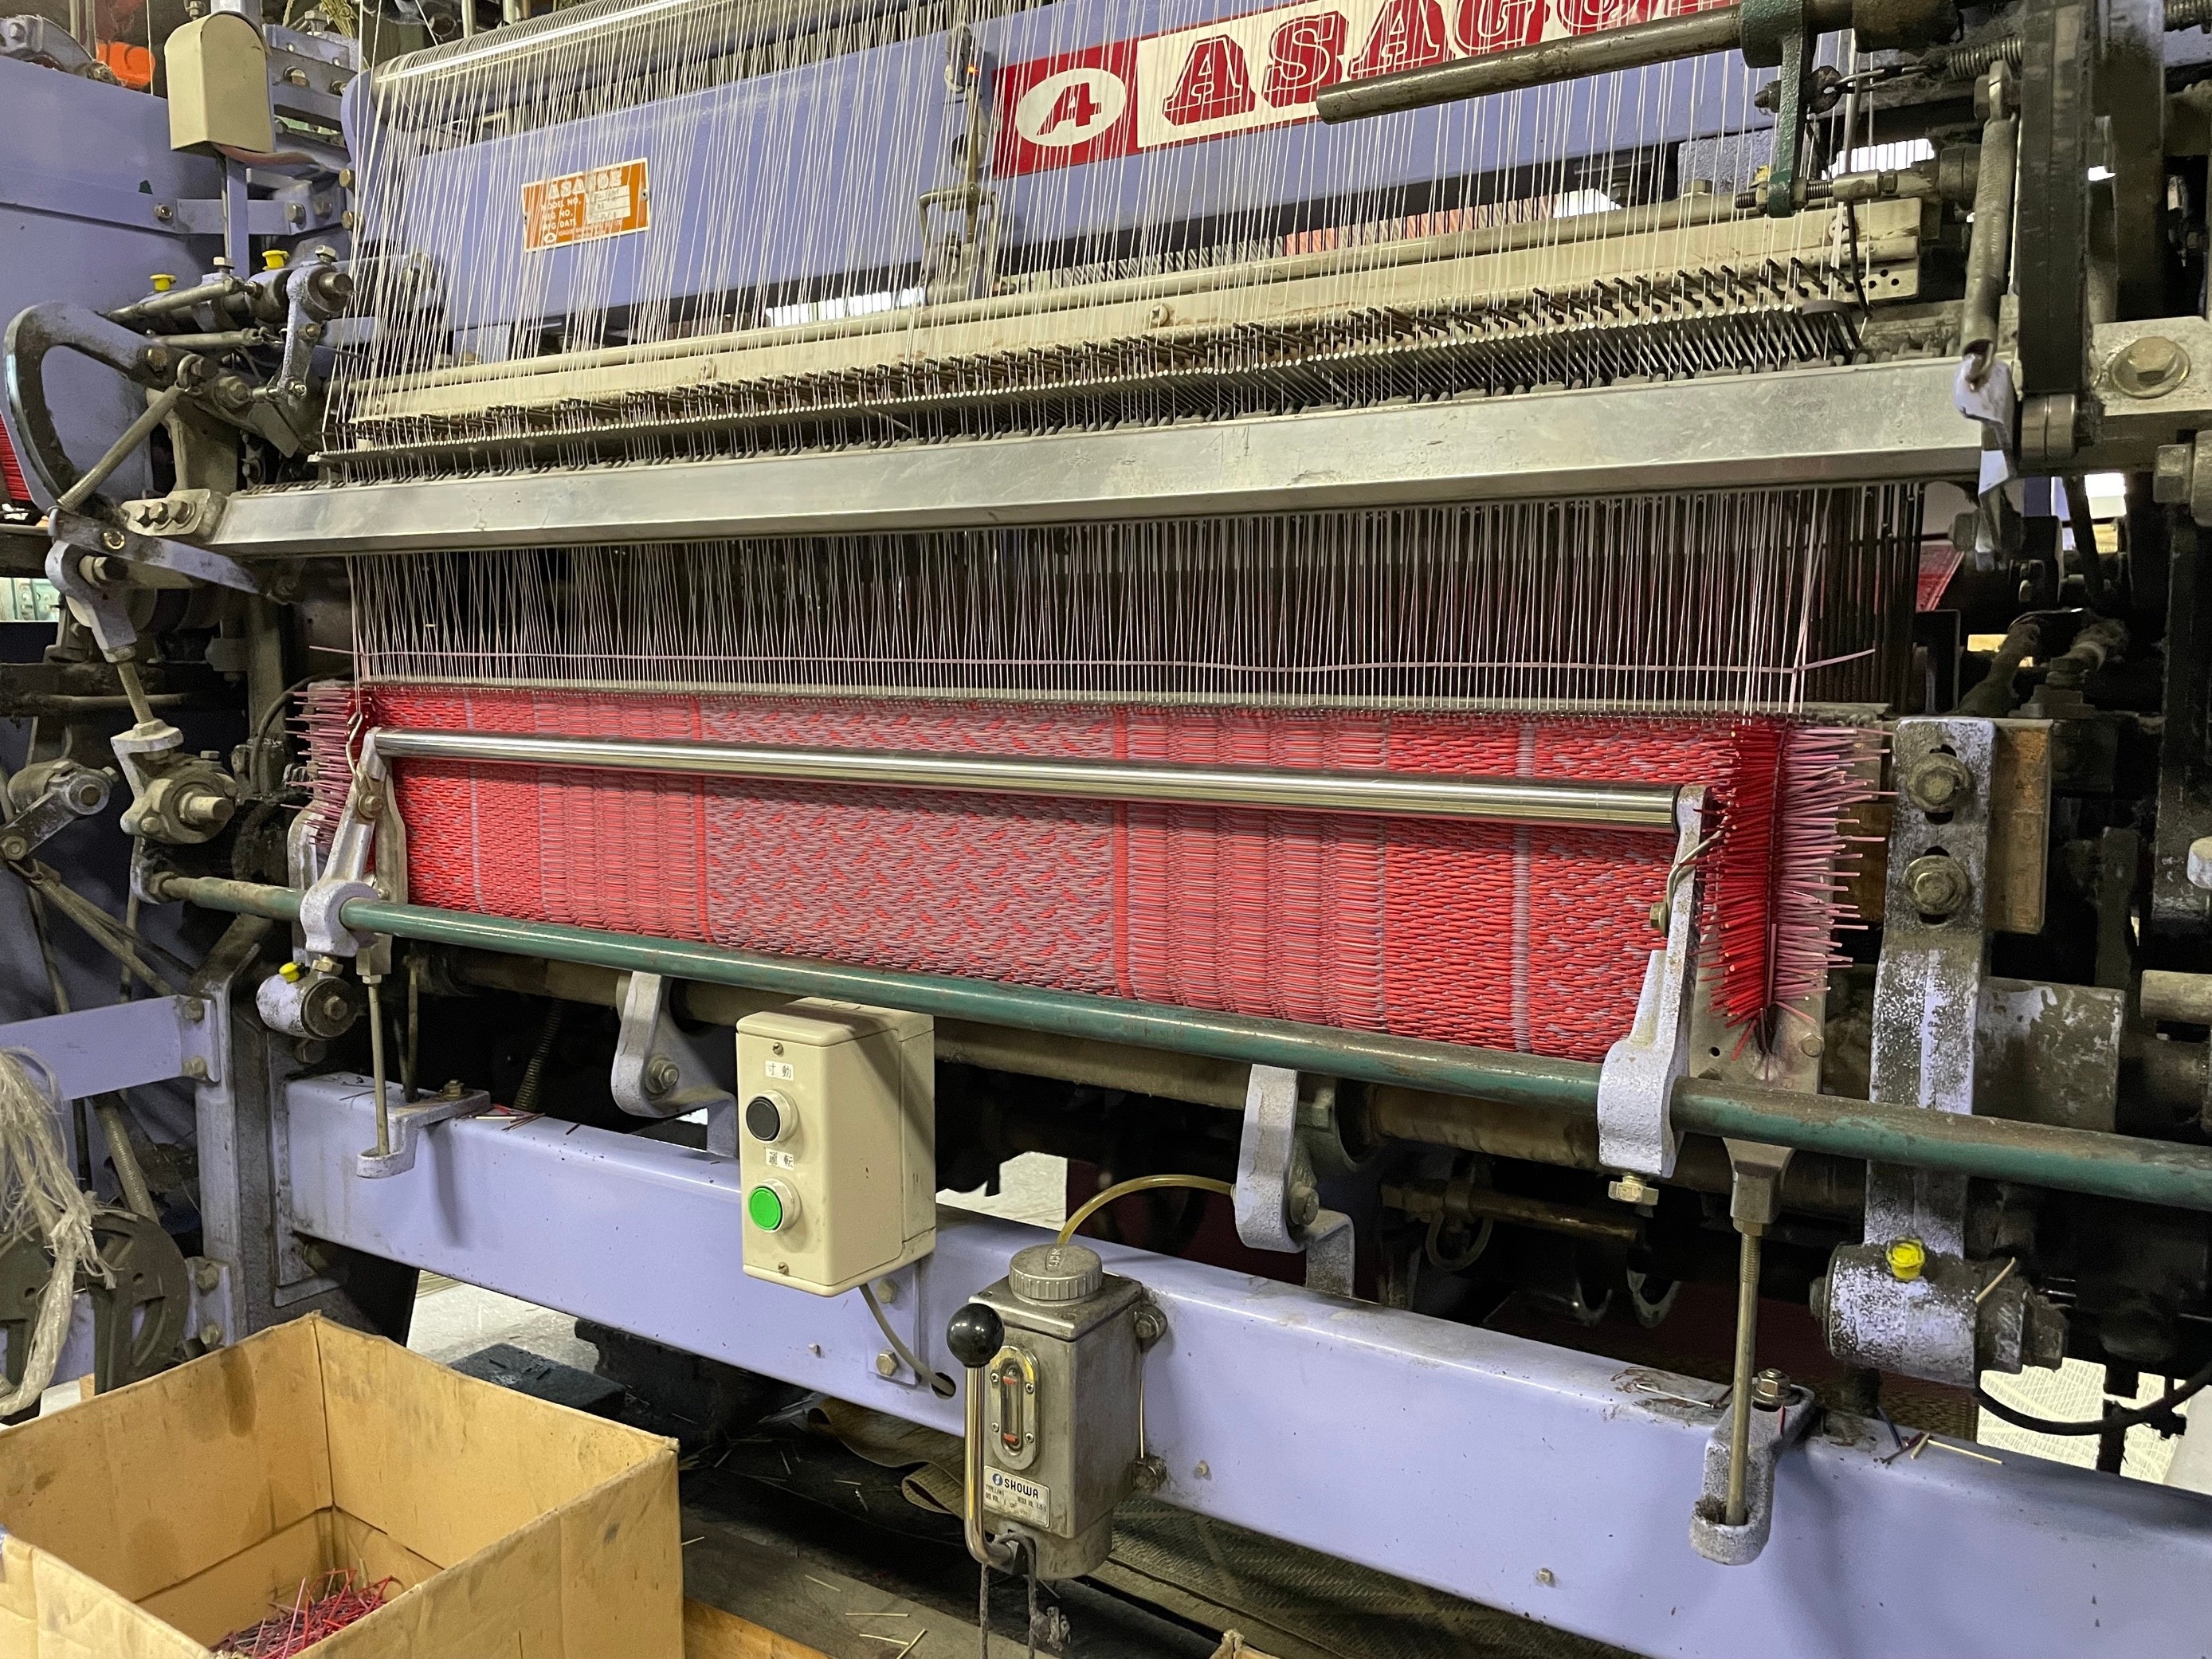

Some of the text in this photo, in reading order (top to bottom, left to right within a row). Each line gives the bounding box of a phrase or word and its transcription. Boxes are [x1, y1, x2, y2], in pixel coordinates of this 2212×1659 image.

[1163, 0, 1733, 126] ASAG
[767, 1063, 791, 1079] 寸動
[768, 1151, 794, 1168] 運転
[1004, 1478, 1039, 1500] SHOWA
